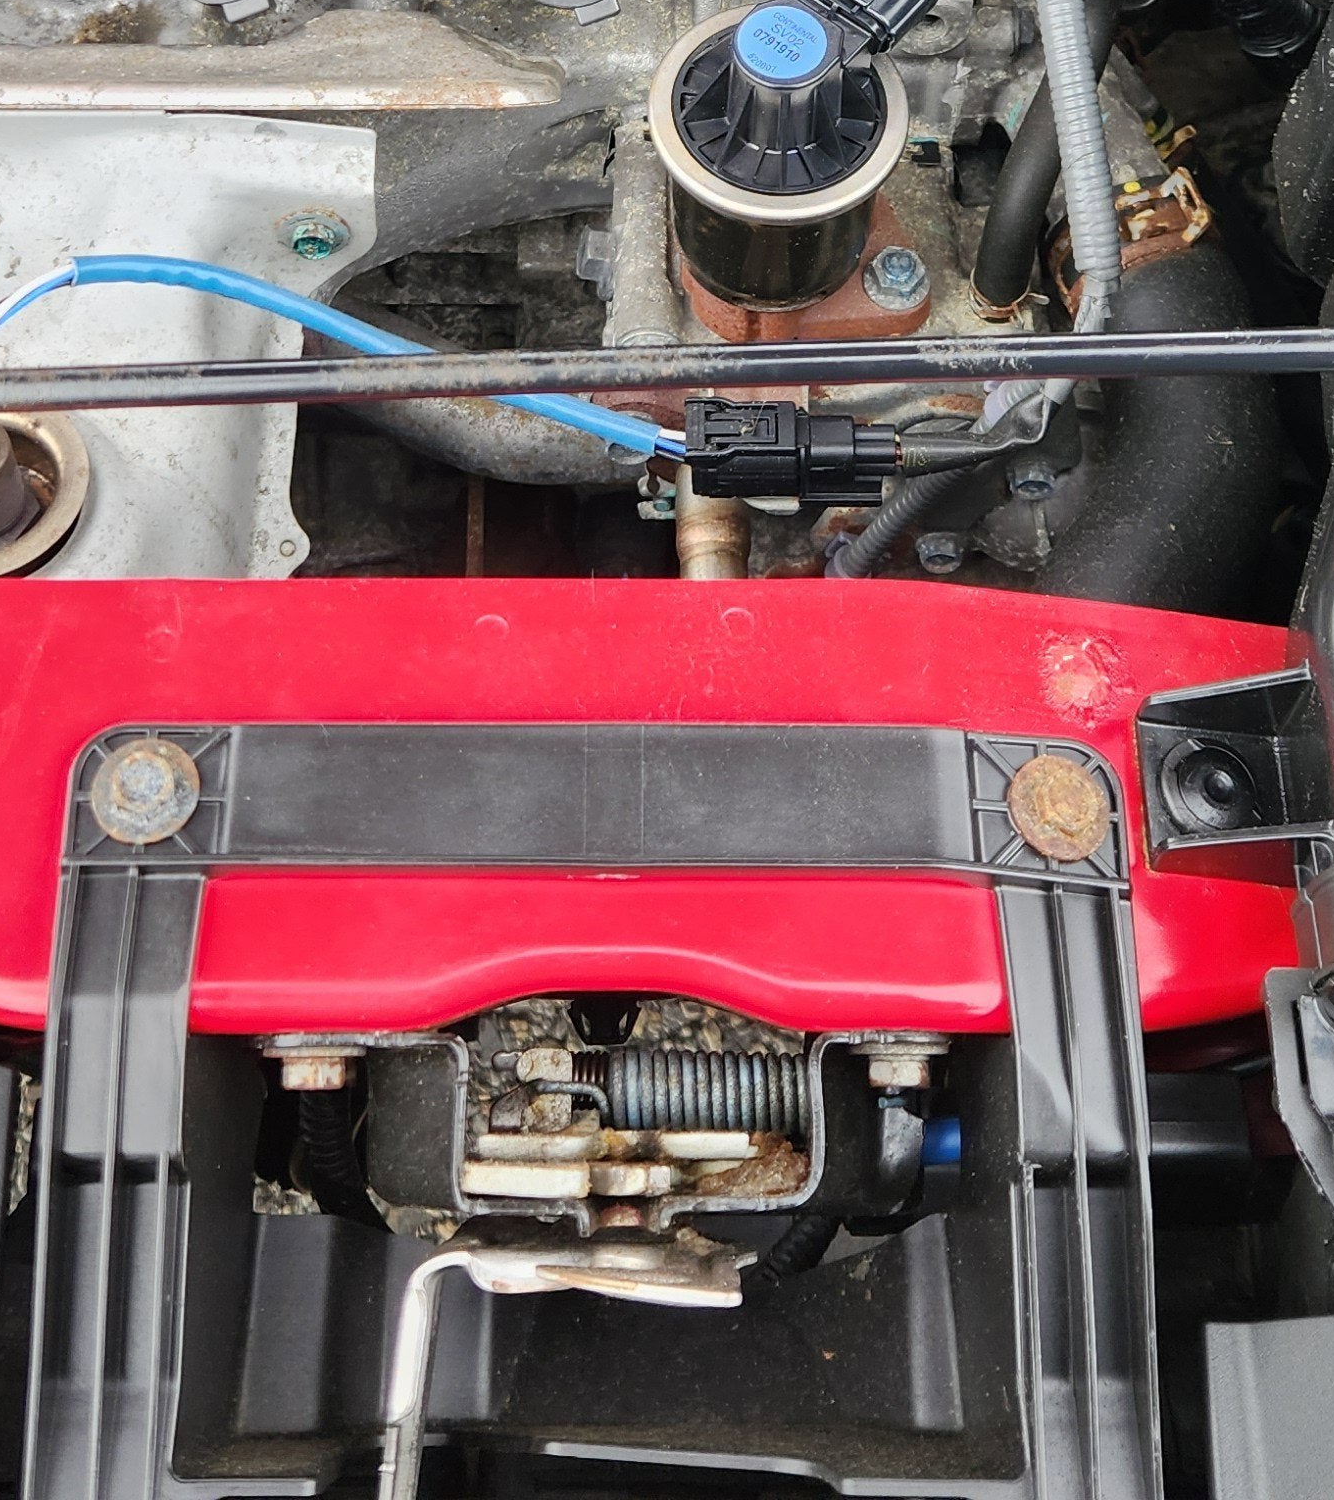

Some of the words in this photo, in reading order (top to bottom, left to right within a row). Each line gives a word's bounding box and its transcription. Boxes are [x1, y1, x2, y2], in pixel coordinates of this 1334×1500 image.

[771, 23, 805, 50] SV02
[773, 11, 818, 44] CONTINENTAL
[753, 28, 800, 63] 0791910
